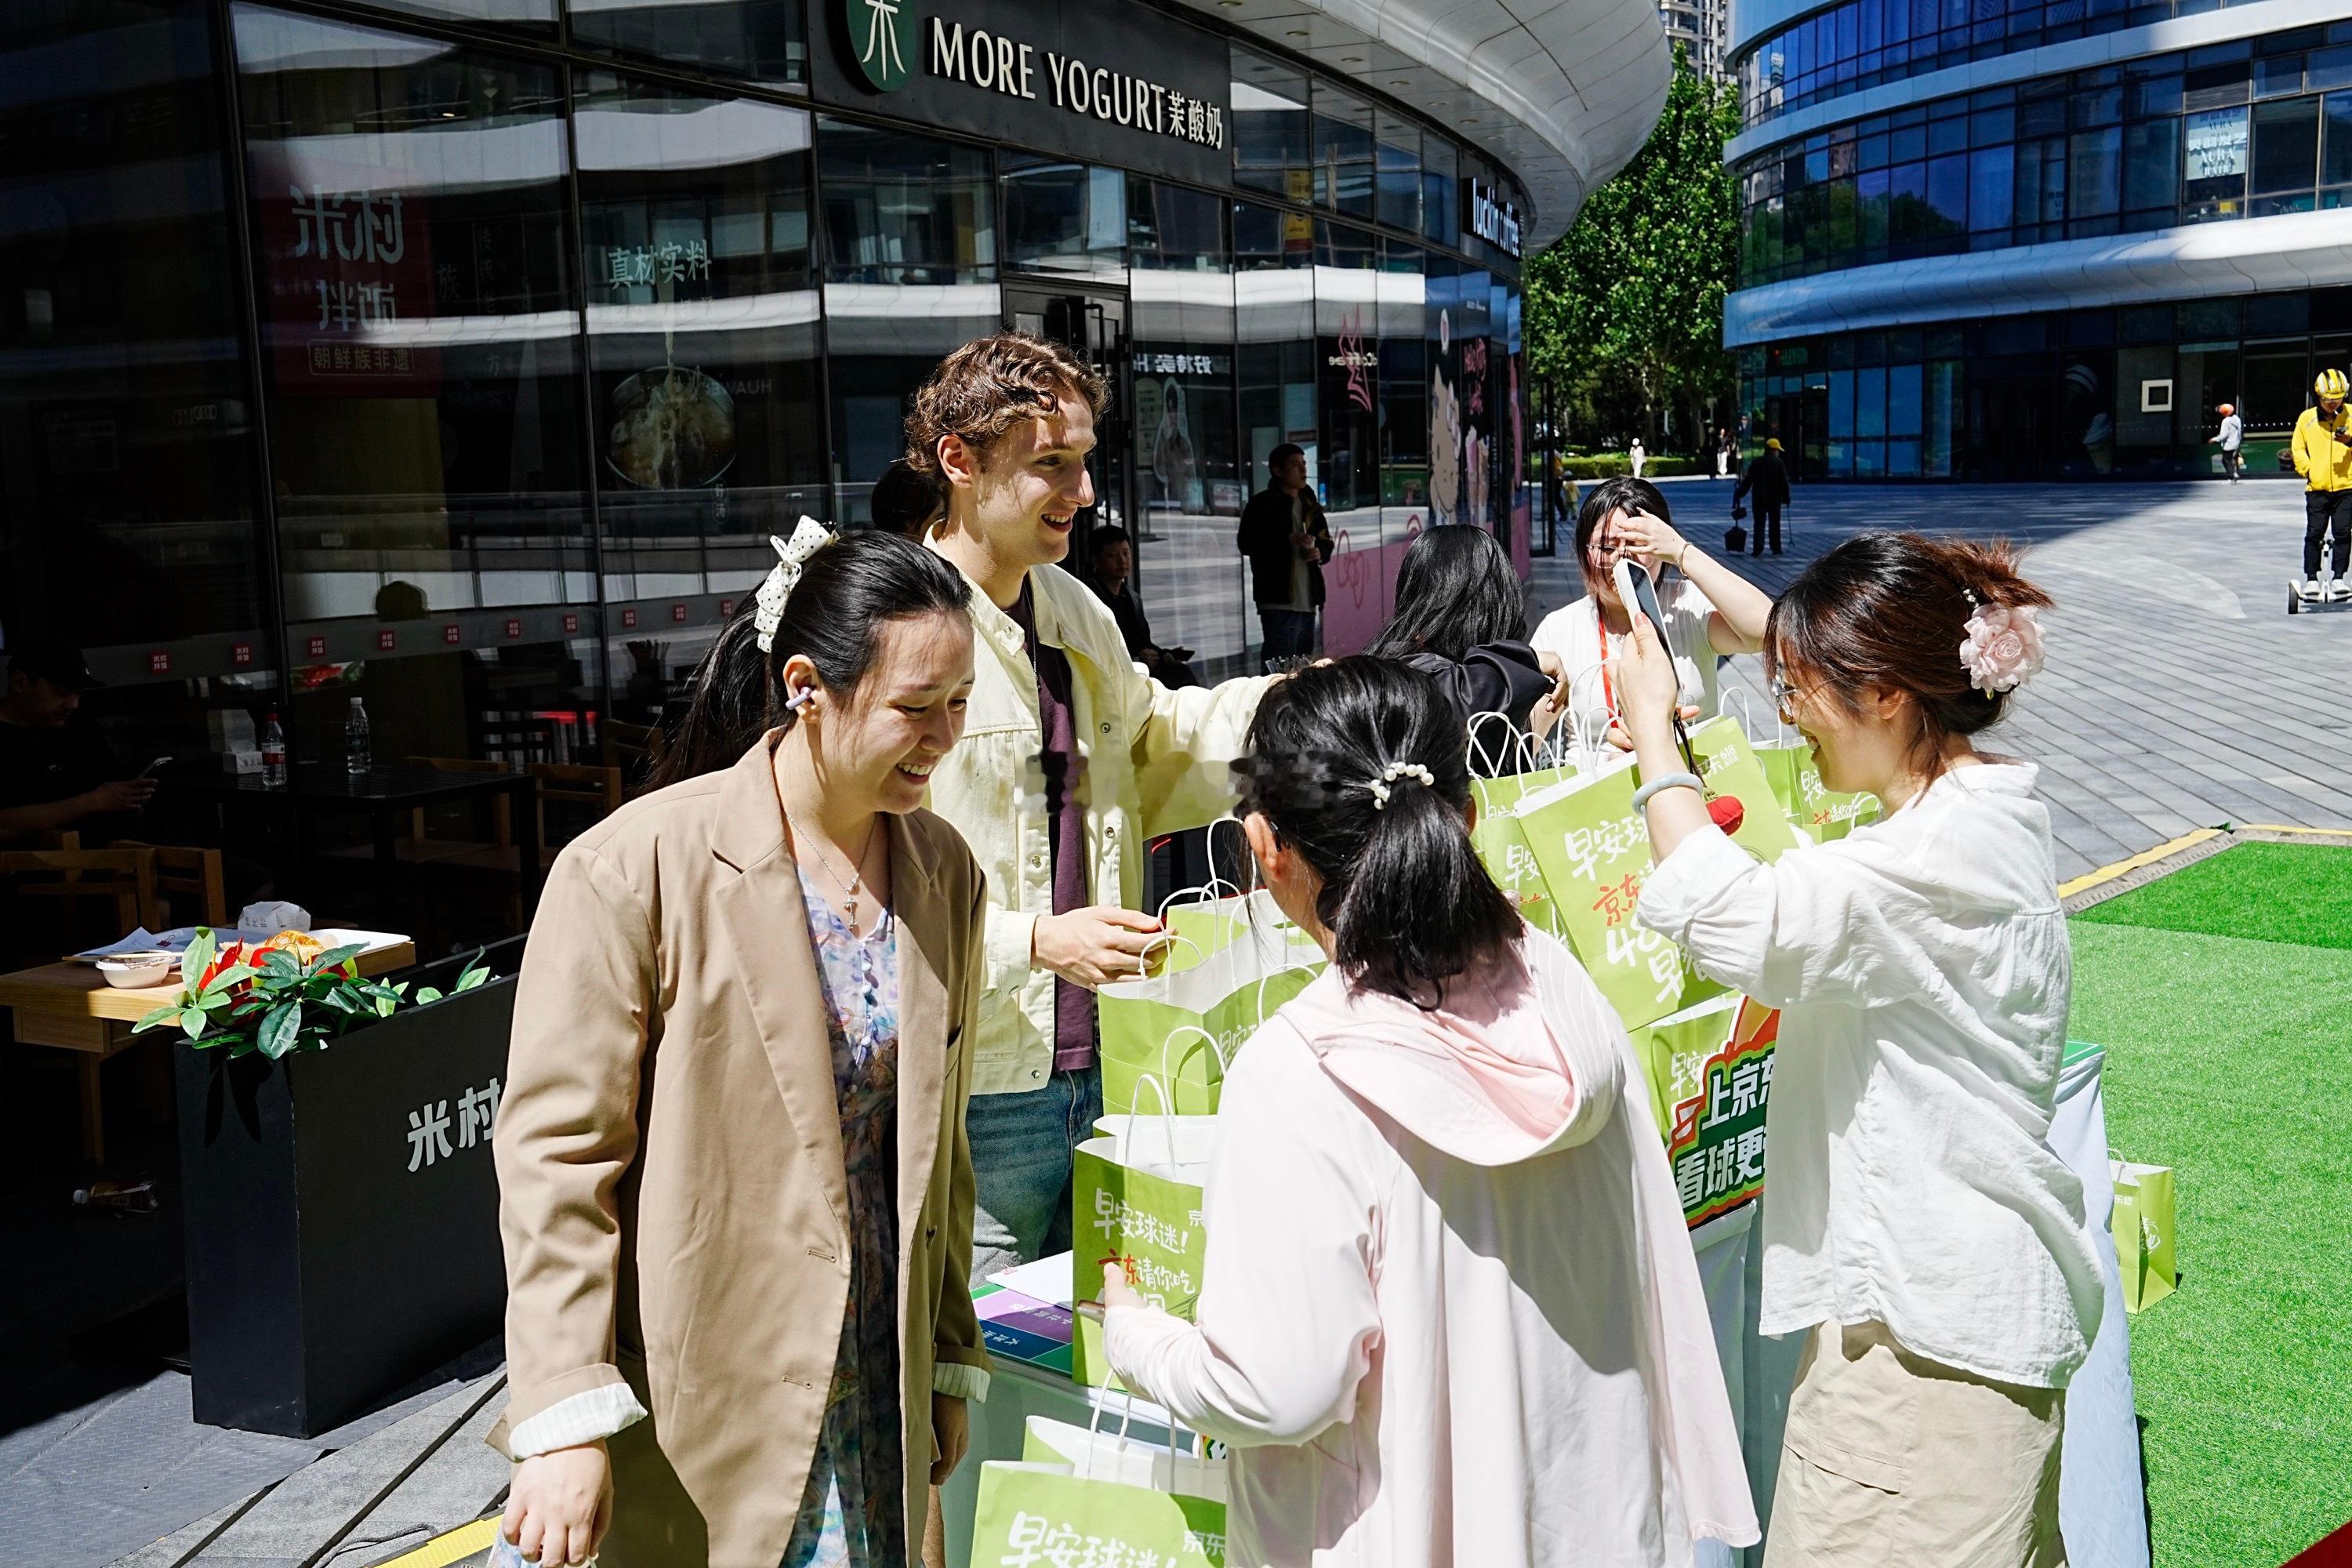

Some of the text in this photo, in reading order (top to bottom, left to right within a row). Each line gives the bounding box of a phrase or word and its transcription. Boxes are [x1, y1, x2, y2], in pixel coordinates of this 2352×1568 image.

[933, 16, 1223, 151] MORE YOGURT 茉酸奶
[289, 184, 405, 264] 米村
[607, 238, 713, 290] 真材实料
[314, 345, 411, 372] 朝鲜族非遗
[407, 1076, 501, 1173] 米村
[1677, 1125, 1767, 1210] 看球更
[1093, 1187, 1189, 1254] 早安球迷!
